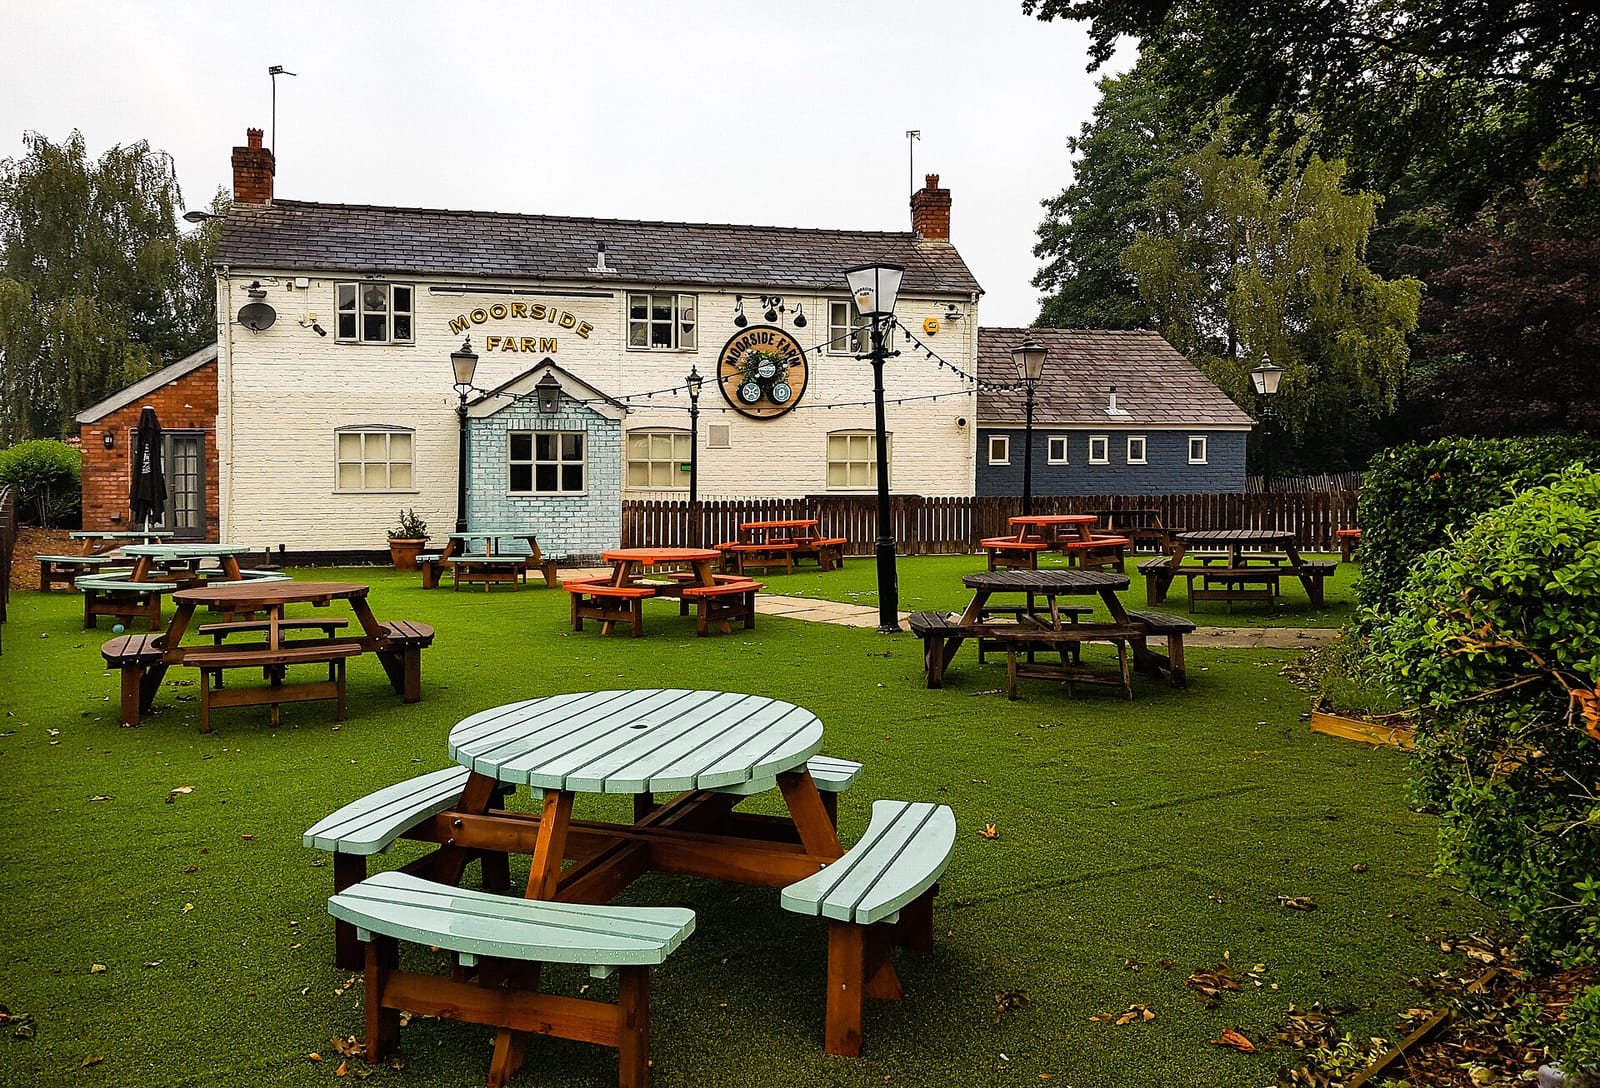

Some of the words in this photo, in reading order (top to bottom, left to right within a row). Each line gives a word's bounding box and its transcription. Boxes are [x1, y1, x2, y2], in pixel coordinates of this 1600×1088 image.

[448, 302, 594, 339] MOORSIDE
[486, 335, 558, 353] FARM
[725, 331, 776, 367] MOORSIDE
[776, 337, 801, 368] FARM
